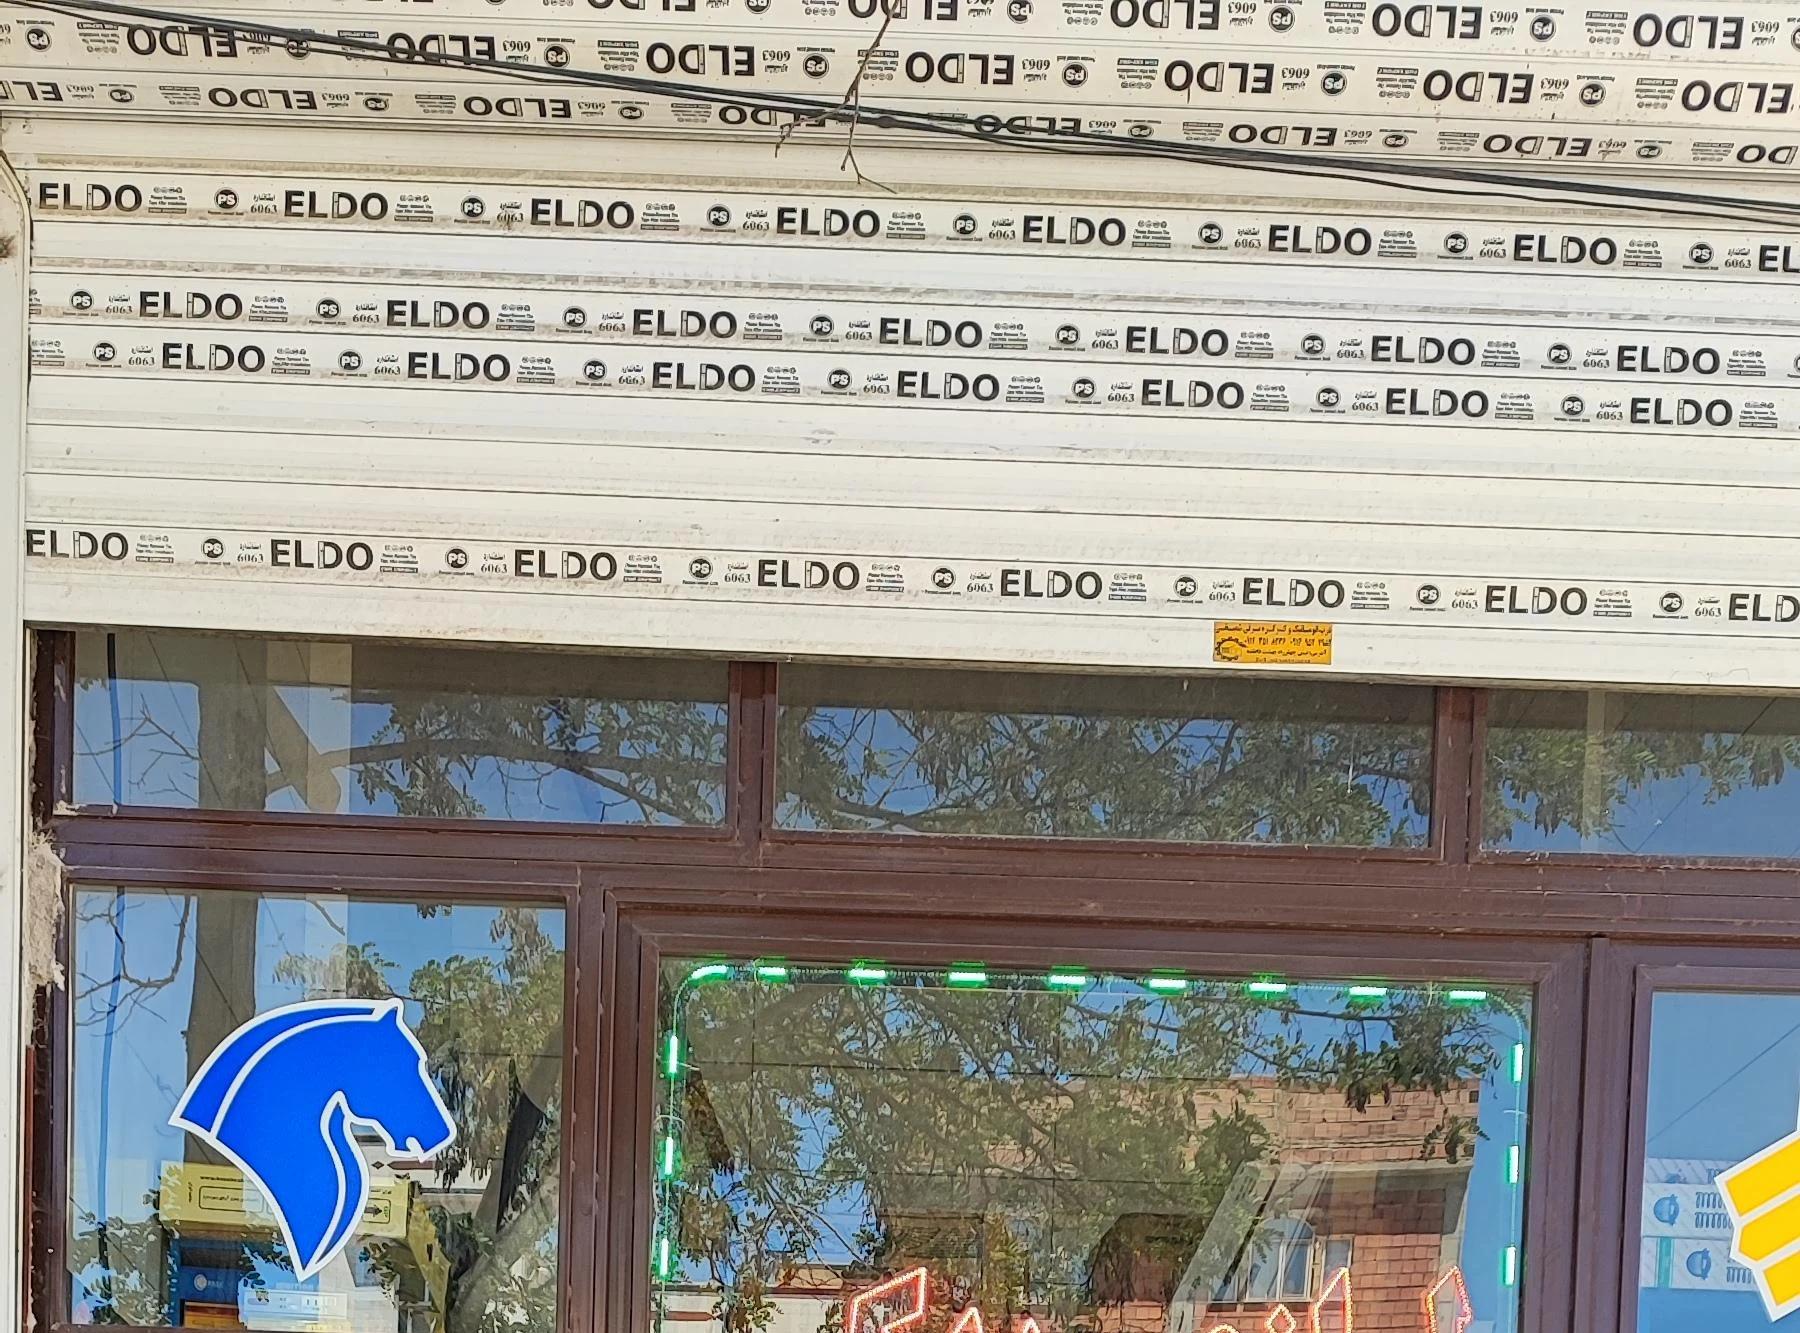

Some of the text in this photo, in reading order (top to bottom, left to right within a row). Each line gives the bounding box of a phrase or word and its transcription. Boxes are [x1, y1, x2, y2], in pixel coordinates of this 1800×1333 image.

[1111, 0, 1220, 30] ELDO
[1373, 4, 1482, 38] ELDO
[127, 26, 238, 58] ELDO
[1634, 15, 1743, 49] ELDO
[646, 43, 754, 76] ELDO
[906, 52, 1014, 84] ELDO
[1165, 61, 1274, 93] ELDO
[1424, 70, 1534, 103] ELDO
[209, 88, 317, 109] ELDO
[464, 97, 571, 118] ELDO
[1682, 80, 1793, 113] ELDO
[1229, 125, 1337, 146] ELDO
[1484, 135, 1592, 156] ELDO
[39, 183, 142, 211] ELDO
[250, 204, 278, 215] 6063
[285, 191, 388, 220] ELDO
[494, 211, 522, 223] 6063
[531, 199, 634, 228] ELDO
[741, 220, 769, 232] 6063
[777, 208, 879, 237] ELDO
[988, 228, 1016, 240] 6063
[1023, 216, 1125, 246] ELDO
[1233, 238, 1262, 250] 6063
[1269, 225, 1371, 255] ELDO
[1479, 246, 1507, 258] 6063
[1514, 235, 1616, 265] ELDO
[1724, 256, 1752, 268] 6063
[104, 304, 133, 316] 6063
[140, 292, 242, 320] ELDO
[352, 312, 380, 324] 6063
[387, 300, 489, 329] ELDO
[596, 321, 624, 333] 6063
[633, 309, 736, 338] ELDO
[844, 330, 873, 341] 6063
[880, 318, 982, 347] ELDO
[1091, 339, 1119, 350] 6063
[1127, 327, 1228, 356] ELDO
[1337, 349, 1365, 360] 6063
[1372, 336, 1475, 365] ELDO
[128, 356, 156, 366] 6063
[163, 343, 265, 372] ELDO
[374, 364, 401, 376] 6063
[408, 352, 510, 381] ELDO
[1582, 358, 1610, 369] 6063
[1618, 346, 1719, 374] ELDO
[618, 375, 646, 386] 6063
[653, 363, 755, 391] ELDO
[862, 384, 891, 395] 6063
[897, 371, 999, 400] ELDO
[1107, 392, 1135, 403] 6063
[1142, 380, 1243, 408] ELDO
[1351, 401, 1379, 412] 6063
[1386, 389, 1488, 417] ELDO
[1595, 410, 1624, 421] 6063
[1631, 398, 1732, 426] ELDO
[26, 530, 128, 560] ELDO
[234, 552, 262, 564] 6063
[271, 540, 373, 570] ELDO
[479, 562, 508, 574] 6063
[515, 550, 616, 580] ELDO
[724, 572, 751, 584] 6063
[758, 560, 859, 590] ELDO
[966, 582, 994, 593] 6063
[1001, 570, 1102, 599] ELDO
[1208, 591, 1236, 602] 6063
[1243, 578, 1344, 608] ELDO
[1451, 598, 1479, 610] 6063
[1486, 586, 1587, 615] ELDO
[1694, 606, 1722, 618] 6063
